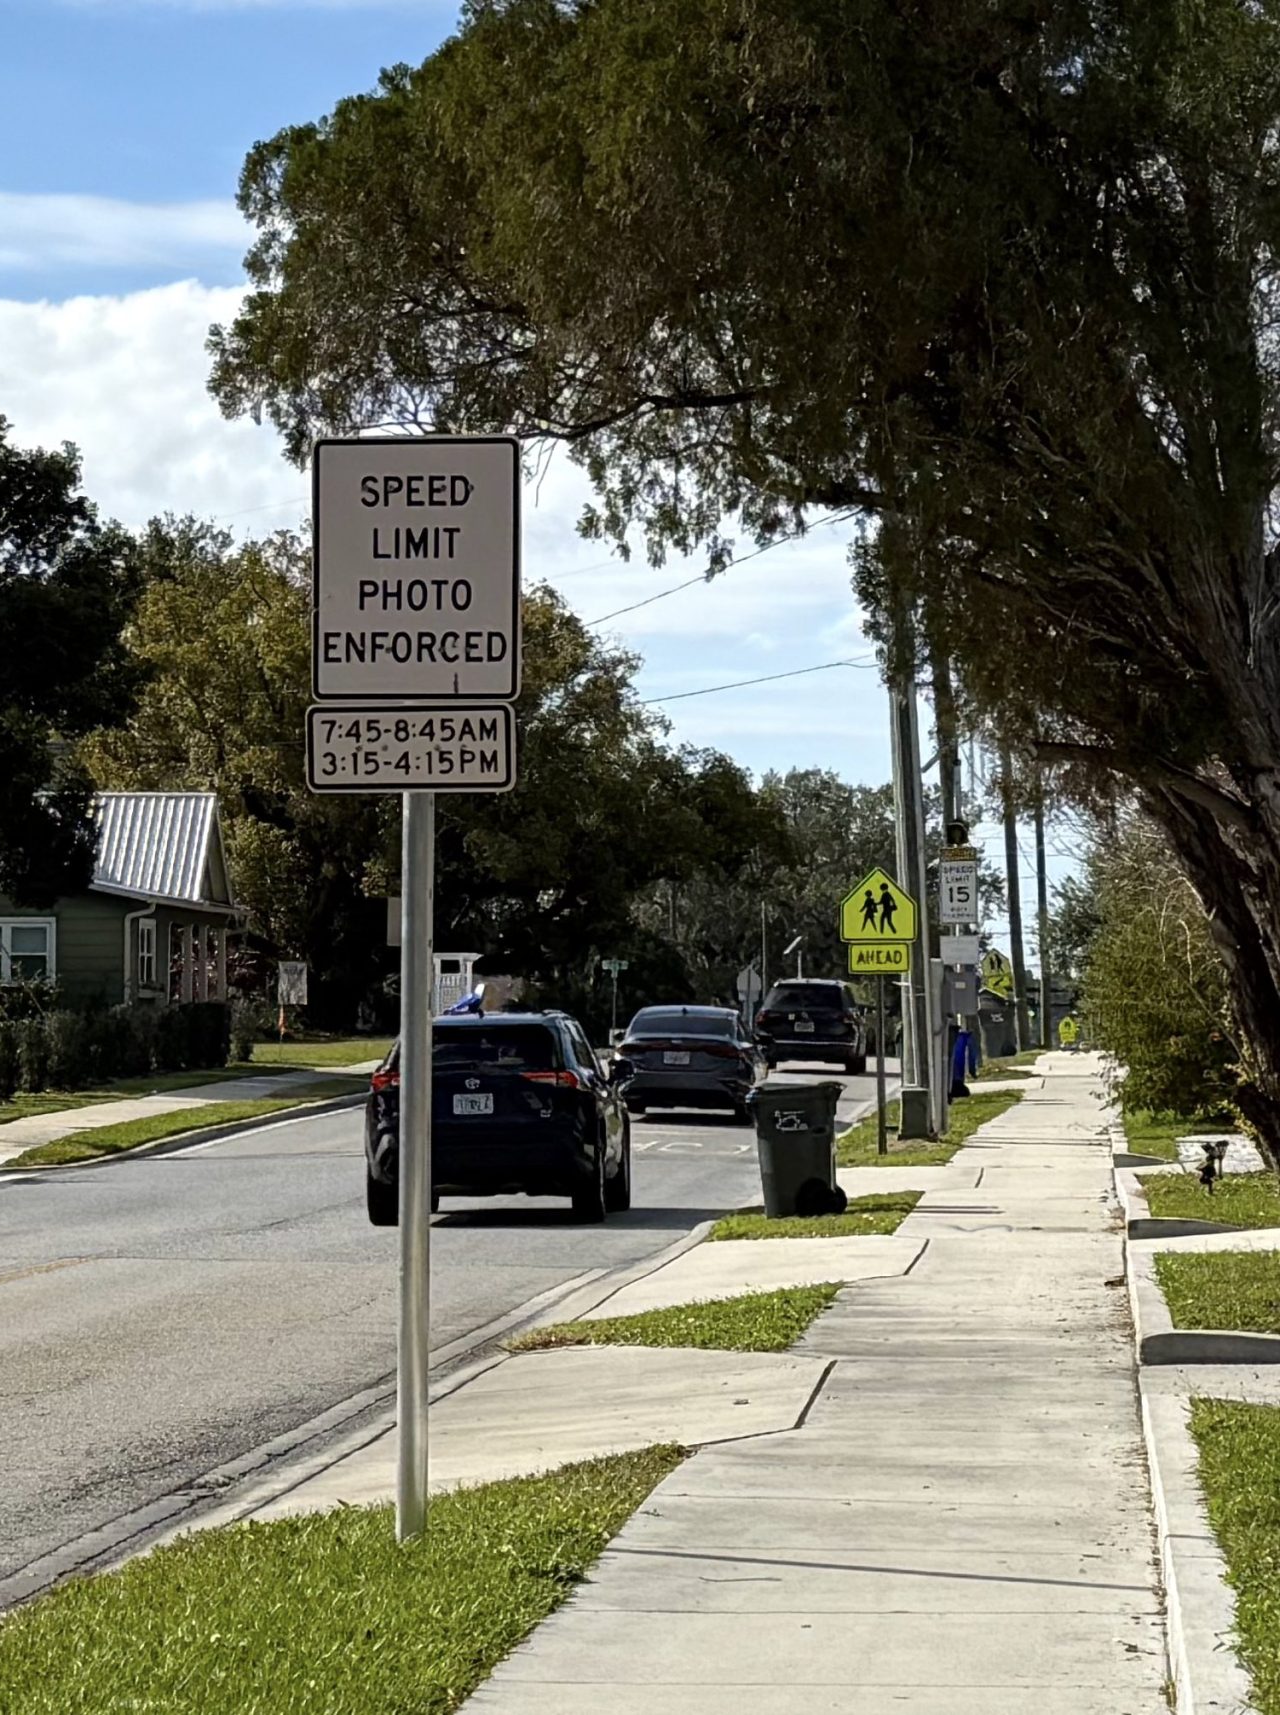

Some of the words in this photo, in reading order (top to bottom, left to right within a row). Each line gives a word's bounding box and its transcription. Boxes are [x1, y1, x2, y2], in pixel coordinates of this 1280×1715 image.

[360, 475, 474, 507] SPEED
[372, 527, 461, 559] LIMIT
[358, 579, 472, 611] PHOTO
[323, 631, 508, 663] ENFORCED
[321, 717, 498, 744] 7:45-8:45AM
[321, 750, 498, 776] 3:15-4:15PM
[948, 886, 970, 903] 15
[856, 950, 903, 965] AHEAD
